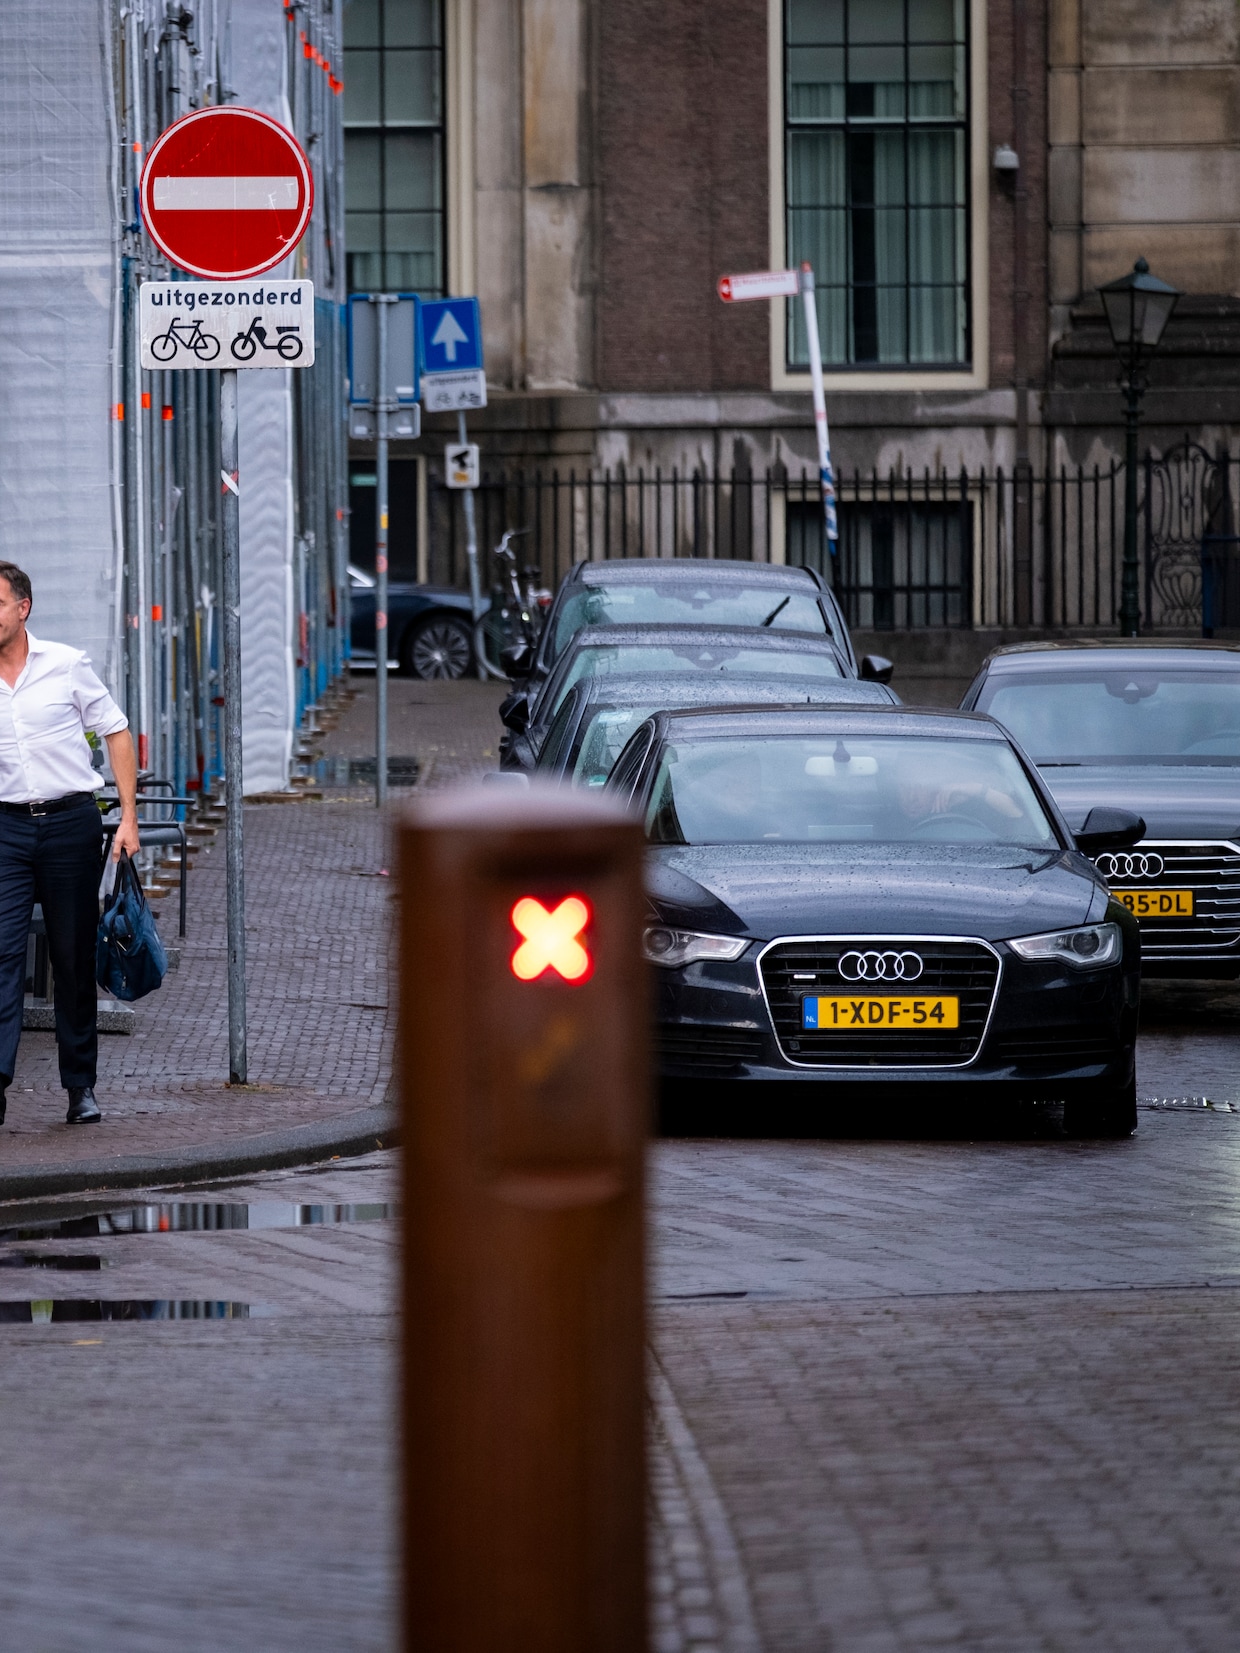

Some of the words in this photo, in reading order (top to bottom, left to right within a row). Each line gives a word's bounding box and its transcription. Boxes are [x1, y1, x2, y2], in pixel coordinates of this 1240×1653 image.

[150, 287, 302, 311] uitgezonderd
[805, 1015, 817, 1023] NL
[830, 1001, 945, 1024] 1-XDF-54
